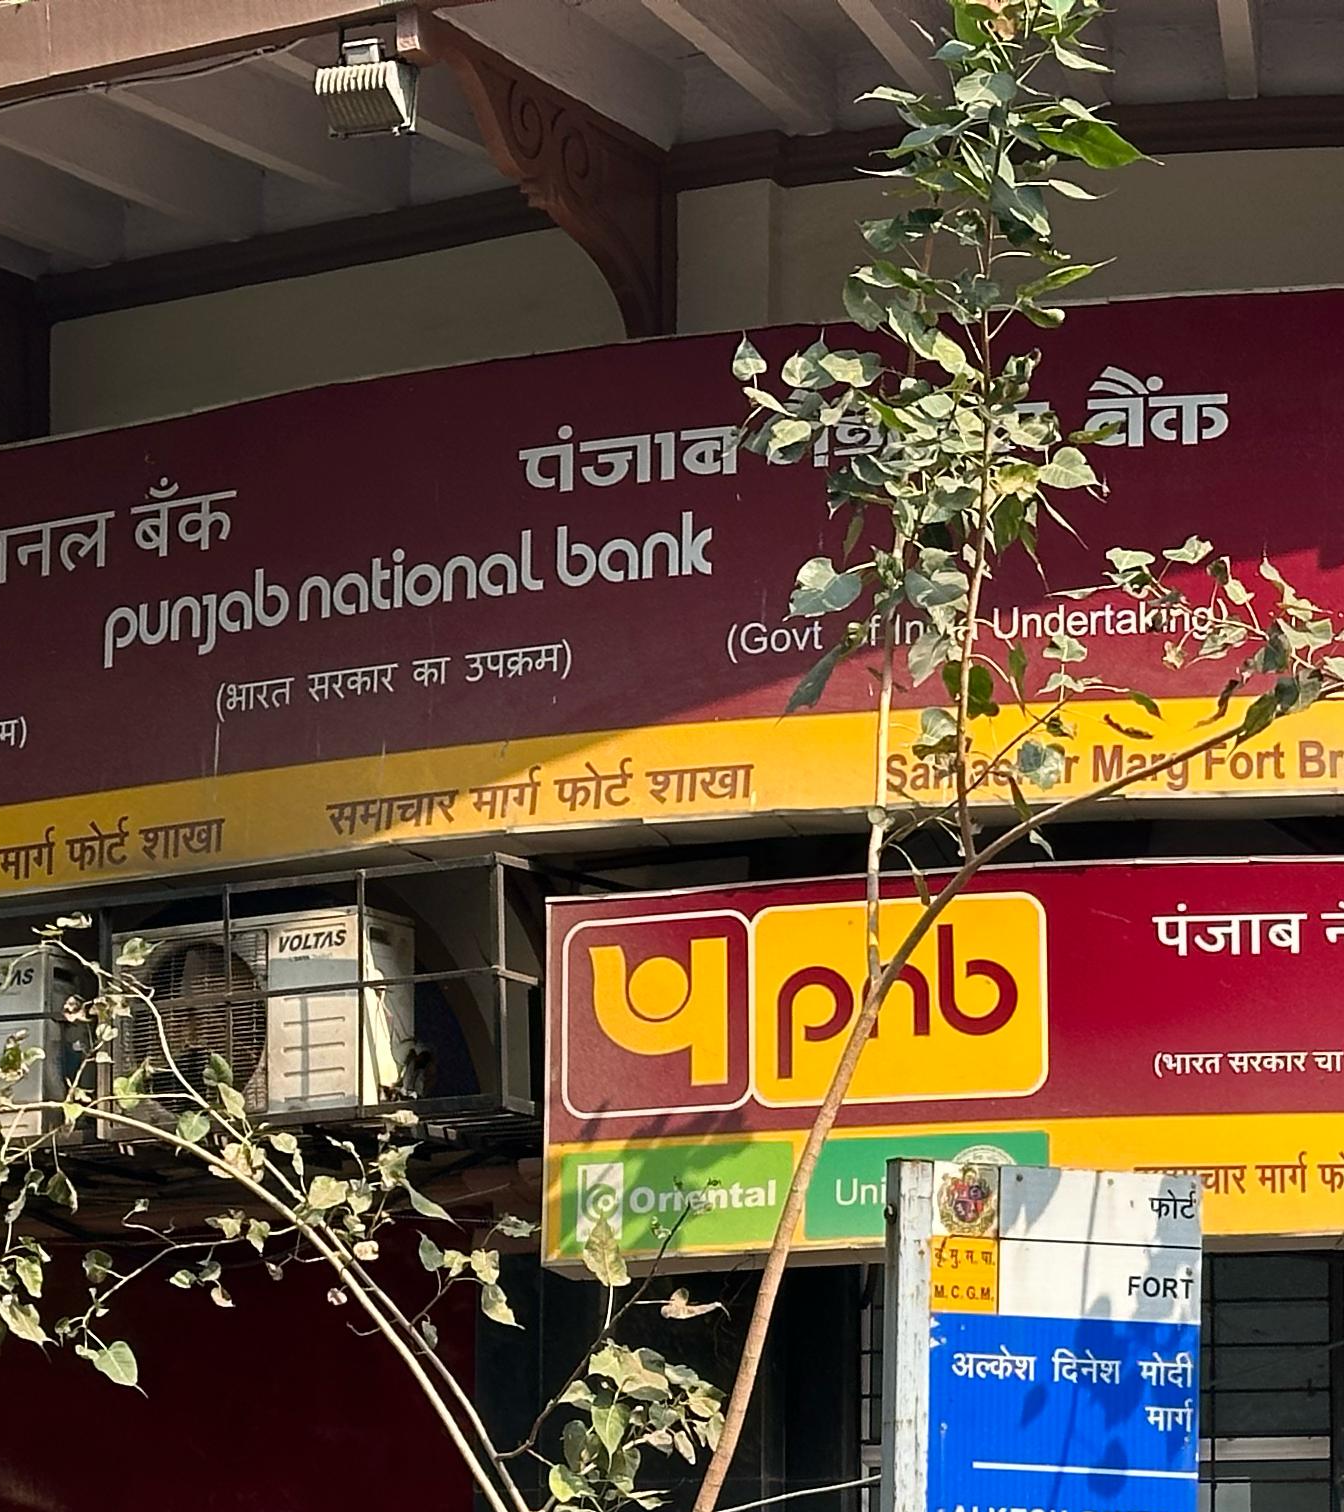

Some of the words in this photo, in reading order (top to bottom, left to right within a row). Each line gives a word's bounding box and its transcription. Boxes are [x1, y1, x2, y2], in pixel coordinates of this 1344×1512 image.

[518, 425, 740, 493] पंजाब
[1086, 366, 1229, 449] बैंक
[130, 476, 238, 558] बँक
[104, 567, 290, 668] punjab
[298, 530, 544, 624] national
[556, 511, 713, 588] bank
[993, 598, 1227, 640] Undertaking)
[215, 675, 292, 723] (भारत
[308, 663, 399, 702] सरकार
[412, 656, 449, 686] का
[464, 640, 573, 682] उपक्रम)
[1092, 744, 1190, 790] Marg
[1205, 740, 1286, 781] Fort
[326, 790, 457, 837] समाचार
[470, 766, 542, 820] मार्ग
[554, 757, 633, 811] फोर्ट
[646, 763, 754, 803] शाखा
[0, 825, 57, 881] मार्ग
[67, 816, 130, 873] फोर्ट
[139, 818, 225, 861] शाखा
[278, 929, 347, 953] VOLTAS
[1153, 902, 1308, 957] पंजाब
[777, 924, 1019, 1079] pnb
[1153, 1050, 1222, 1079] (भारत
[1228, 1050, 1308, 1076] सरकार
[1314, 1049, 1343, 1075] चा
[1255, 1152, 1307, 1194] मार्ग
[630, 1180, 776, 1214] Oriental
[1149, 1190, 1197, 1221] फोर्ट
[1128, 1275, 1195, 1300] FORT
[952, 1345, 1036, 1381] अल्केश
[1052, 1347, 1122, 1385] दिनेश
[1138, 1350, 1193, 1388] मोदी
[1145, 1398, 1193, 1434] मार्ग
